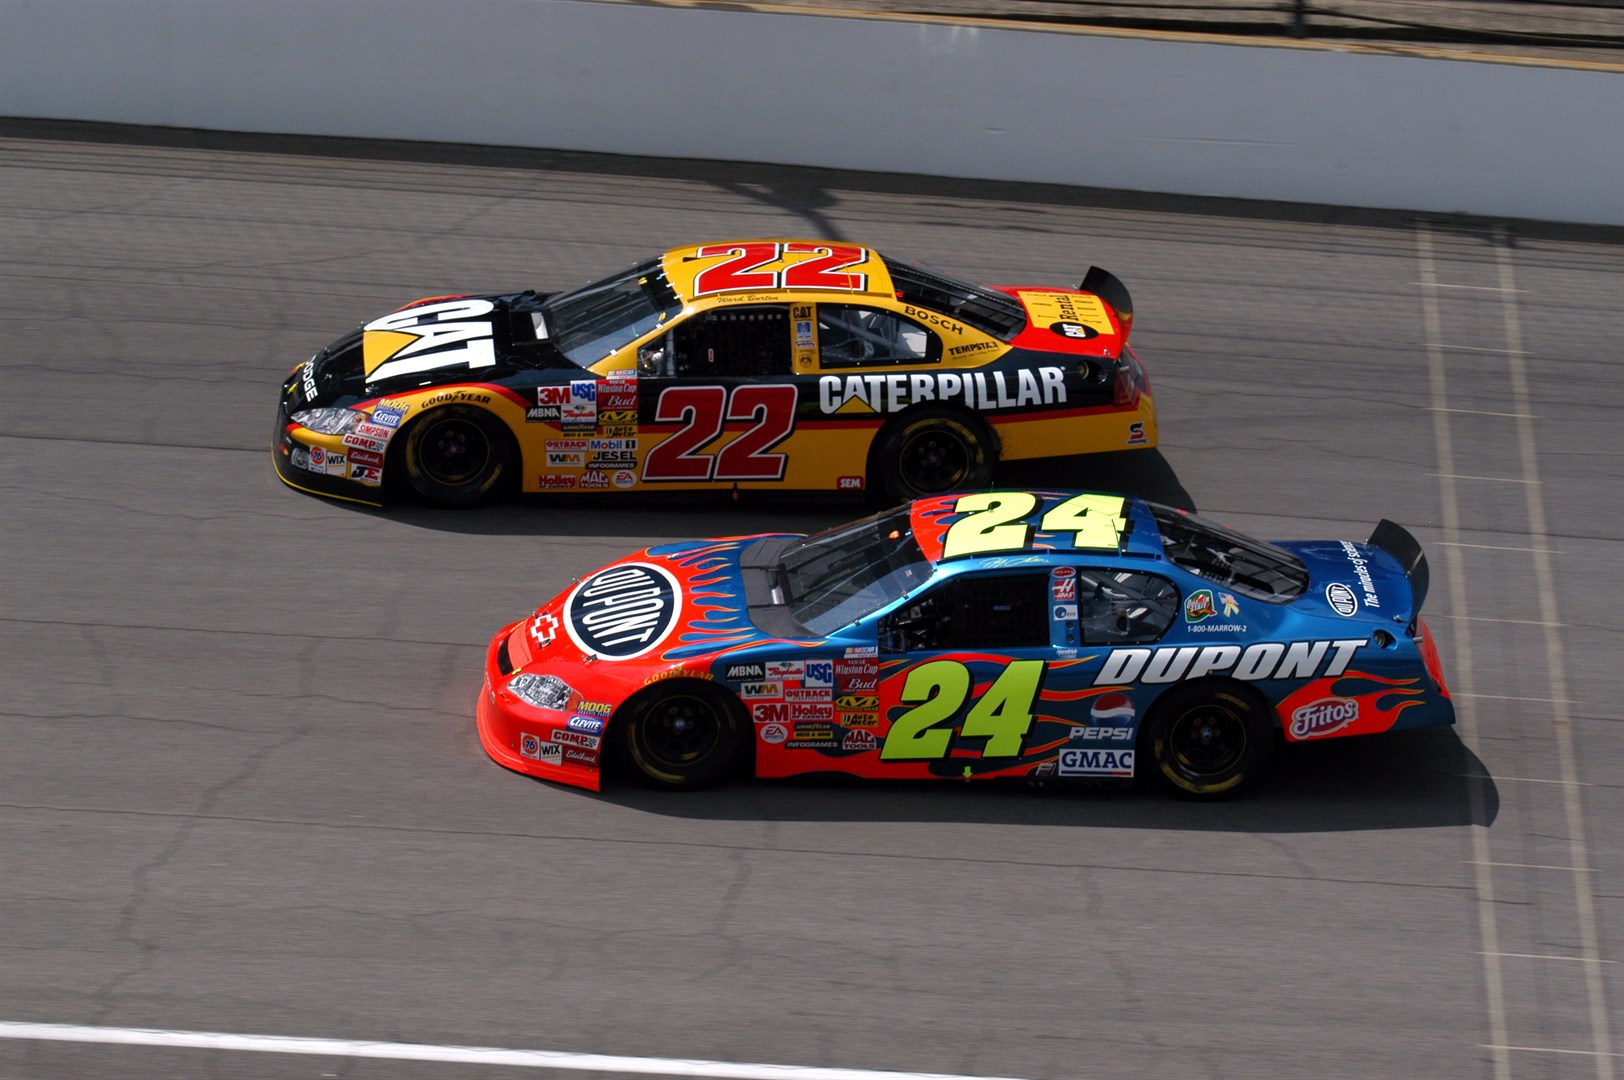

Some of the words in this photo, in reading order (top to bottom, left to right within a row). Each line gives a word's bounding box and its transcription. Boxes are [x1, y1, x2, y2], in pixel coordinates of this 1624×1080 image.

[694, 242, 867, 296] 22
[717, 295, 744, 303] Ward
[747, 294, 778, 302] Burton
[793, 306, 812, 319] CAT
[904, 305, 964, 335] BOSCH
[1062, 323, 1087, 338] CAT
[363, 299, 496, 384] CAT
[571, 383, 596, 402] USG
[598, 384, 623, 393] Winston
[623, 383, 637, 393] Cup
[819, 365, 1067, 414] CATERPILLAR
[421, 391, 491, 409] GOODYEAR
[539, 387, 571, 405] 3M
[608, 396, 637, 406] Bud
[380, 398, 410, 411] MOOG
[527, 407, 560, 418] MBNA
[358, 424, 389, 439] SIMPSON
[641, 383, 798, 482] 22
[344, 435, 376, 448] COMP
[591, 440, 622, 449] Mobil
[313, 451, 322, 461] 76
[328, 455, 345, 464] WIX
[593, 451, 637, 460] JESEL
[352, 466, 380, 481] JE
[580, 470, 608, 483] MAC
[616, 472, 633, 480] EA
[539, 474, 575, 488] Holley
[840, 478, 861, 488] SEM
[943, 492, 1126, 558] 24
[1353, 565, 1376, 593] miracles
[1363, 593, 1380, 608] The
[1187, 624, 1247, 633] 1-800-MARROW-2
[835, 664, 863, 675] Winston
[863, 663, 878, 675] Cup
[1093, 639, 1369, 686] DUPONT
[643, 669, 714, 686] GOODYEAR
[727, 665, 763, 677] MBNA
[806, 663, 832, 684] USG
[849, 678, 877, 688] Bud
[578, 701, 612, 714] MOOG
[755, 705, 789, 721] 3M
[792, 704, 832, 719] Holley
[879, 660, 1046, 761] 24
[1293, 702, 1356, 735] Fritos
[765, 726, 784, 735] EA
[844, 730, 876, 743] MAC
[1069, 727, 1134, 740] PEPSI
[525, 740, 535, 751] 76
[553, 731, 588, 746] COMP
[541, 745, 560, 756] WIX
[566, 749, 598, 764] Edelbrock
[1061, 750, 1133, 769] GMAC
